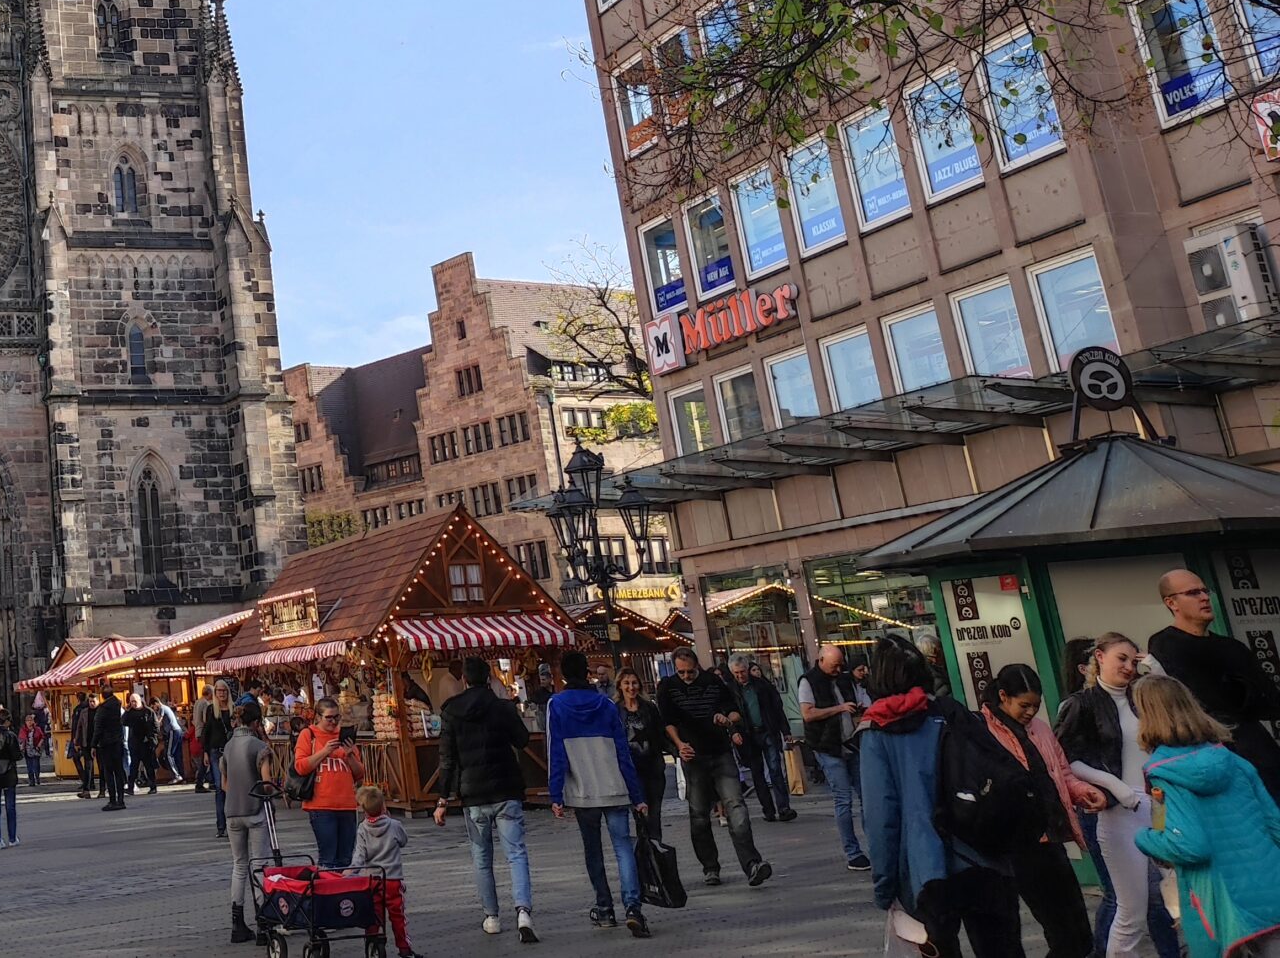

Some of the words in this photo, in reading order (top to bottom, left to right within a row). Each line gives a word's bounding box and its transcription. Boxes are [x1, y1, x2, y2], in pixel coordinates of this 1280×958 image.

[934, 154, 978, 183] JAZZ/BLUES
[811, 217, 837, 237] KLASSIK
[706, 270, 719, 283] NEW
[719, 265, 730, 279] AGE
[679, 283, 793, 355] Müller
[655, 331, 670, 357] M
